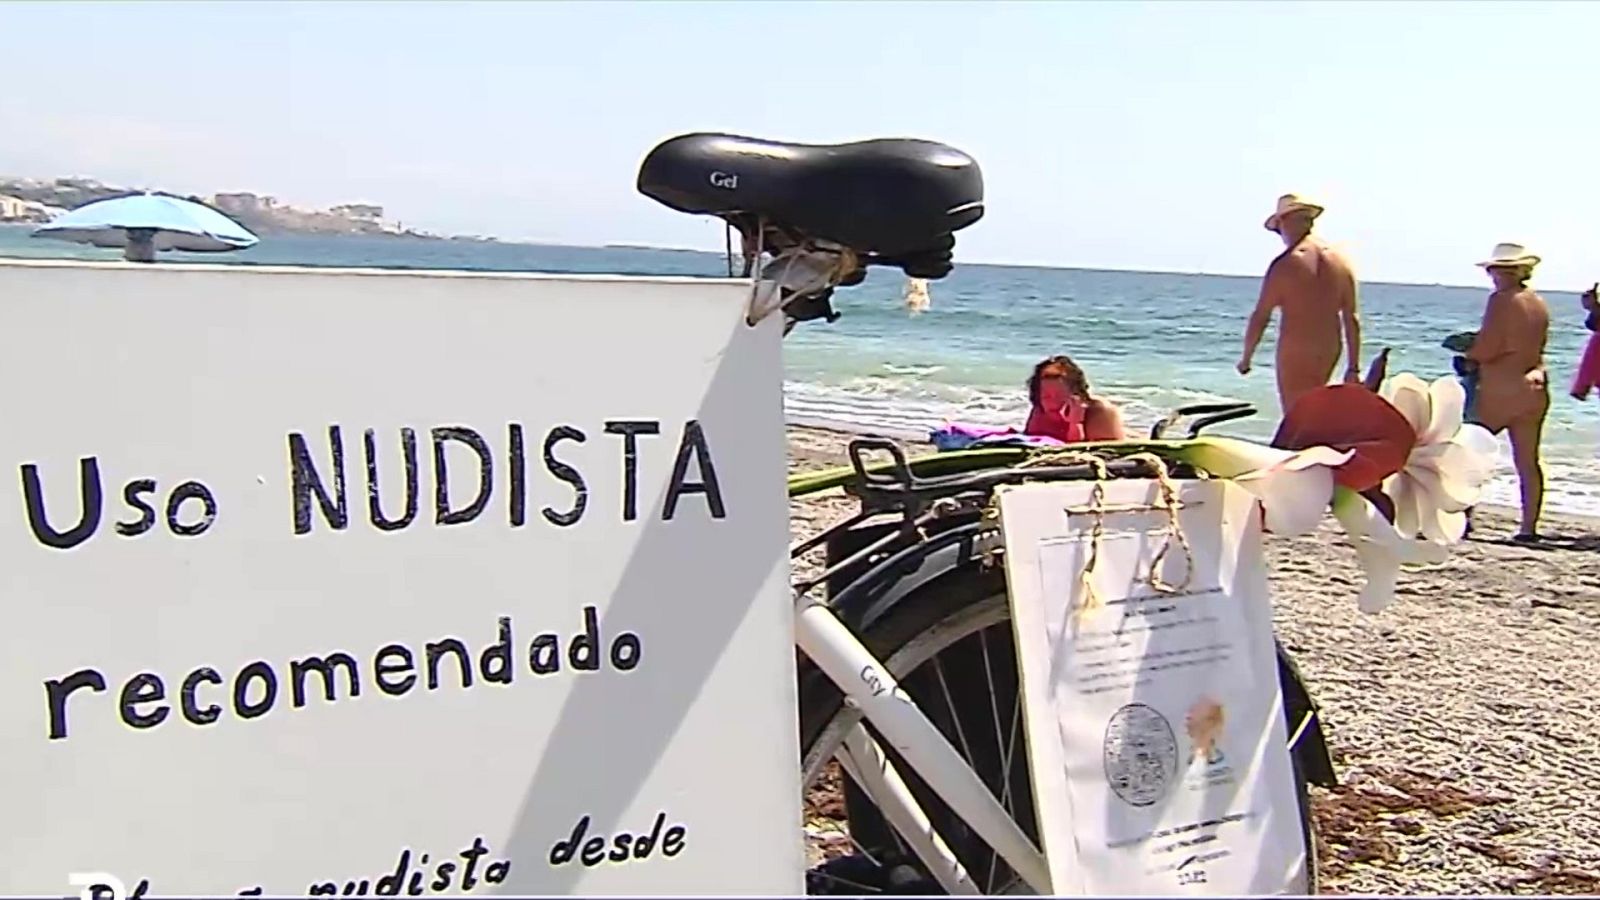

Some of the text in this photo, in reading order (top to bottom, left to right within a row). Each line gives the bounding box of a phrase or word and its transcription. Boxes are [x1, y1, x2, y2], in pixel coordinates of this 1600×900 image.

[710, 171, 738, 189] Gel
[21, 420, 726, 550] Uso NUDISTA
[45, 607, 642, 739] recomendado
[549, 812, 687, 867] desde
